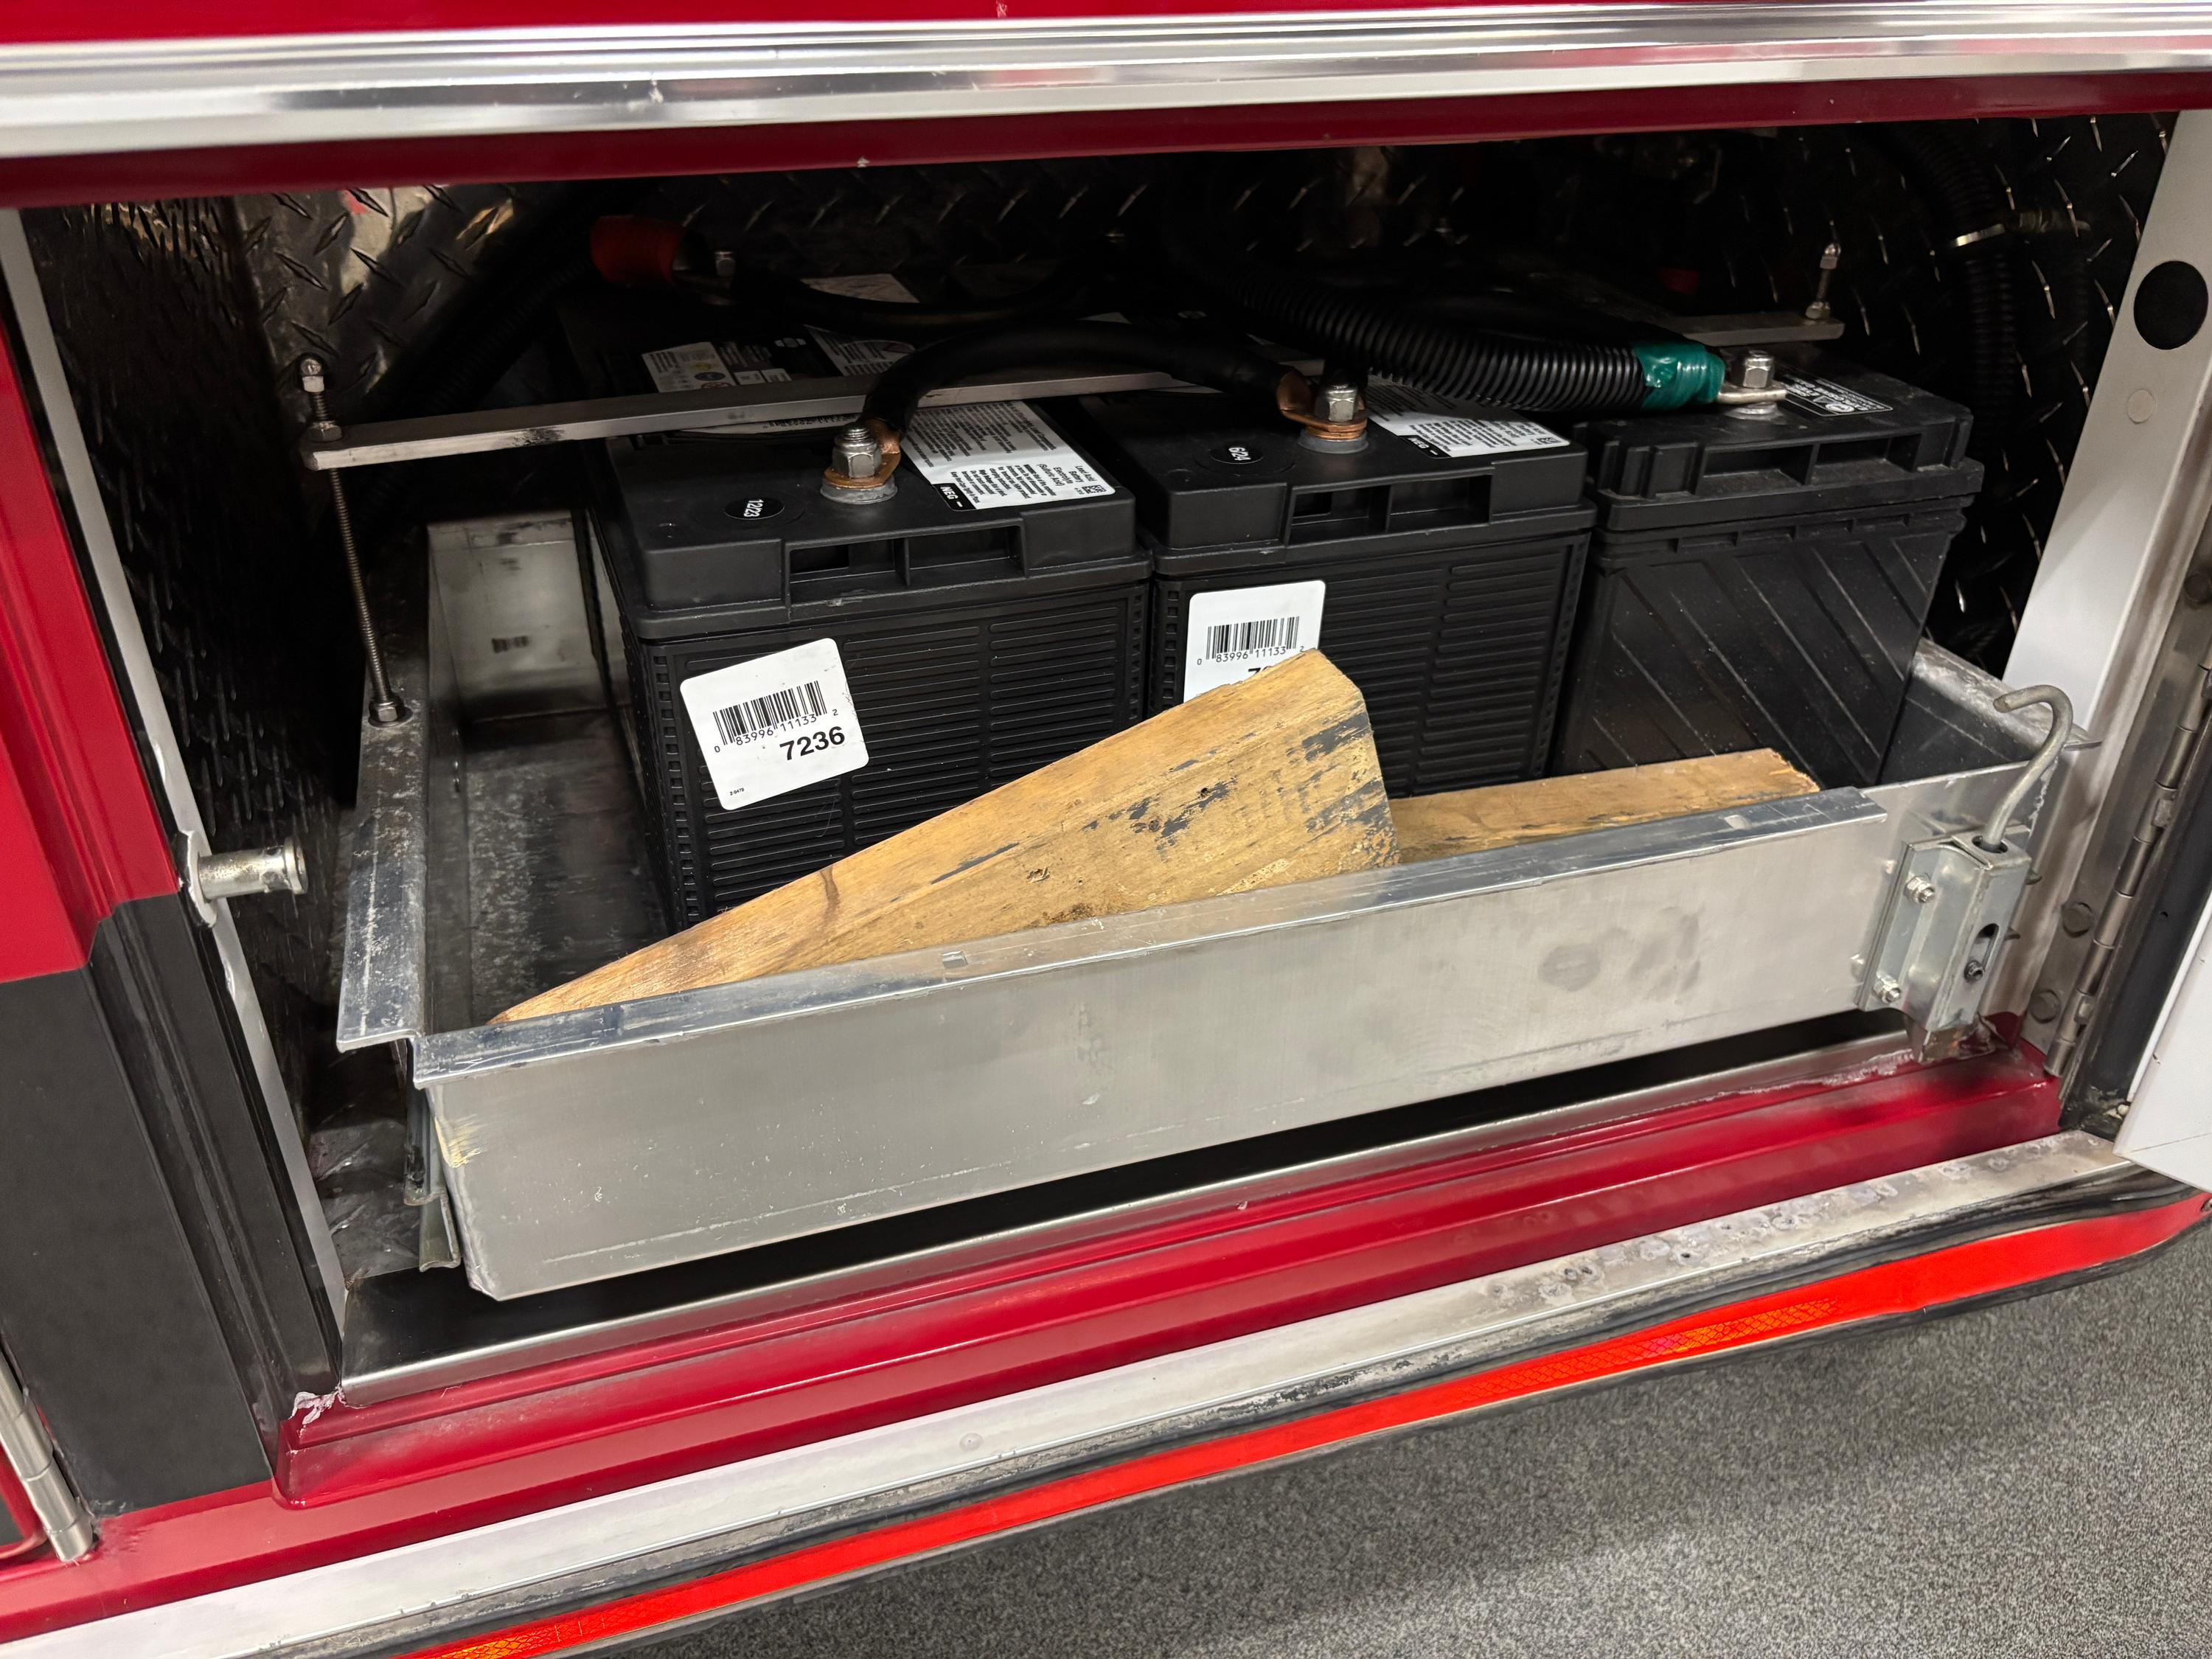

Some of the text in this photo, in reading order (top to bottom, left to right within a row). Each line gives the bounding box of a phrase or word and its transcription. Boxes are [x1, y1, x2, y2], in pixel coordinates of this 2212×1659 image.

[1228, 447, 1251, 461] 6/24
[1068, 471, 1085, 482] Battery
[940, 487, 959, 500] NEG
[743, 499, 764, 517] 12/23
[1216, 652, 1248, 663] 83996
[1256, 646, 1286, 658] 11133
[736, 727, 773, 745] 83996
[780, 714, 817, 731] 11133
[779, 726, 845, 761] 7236
